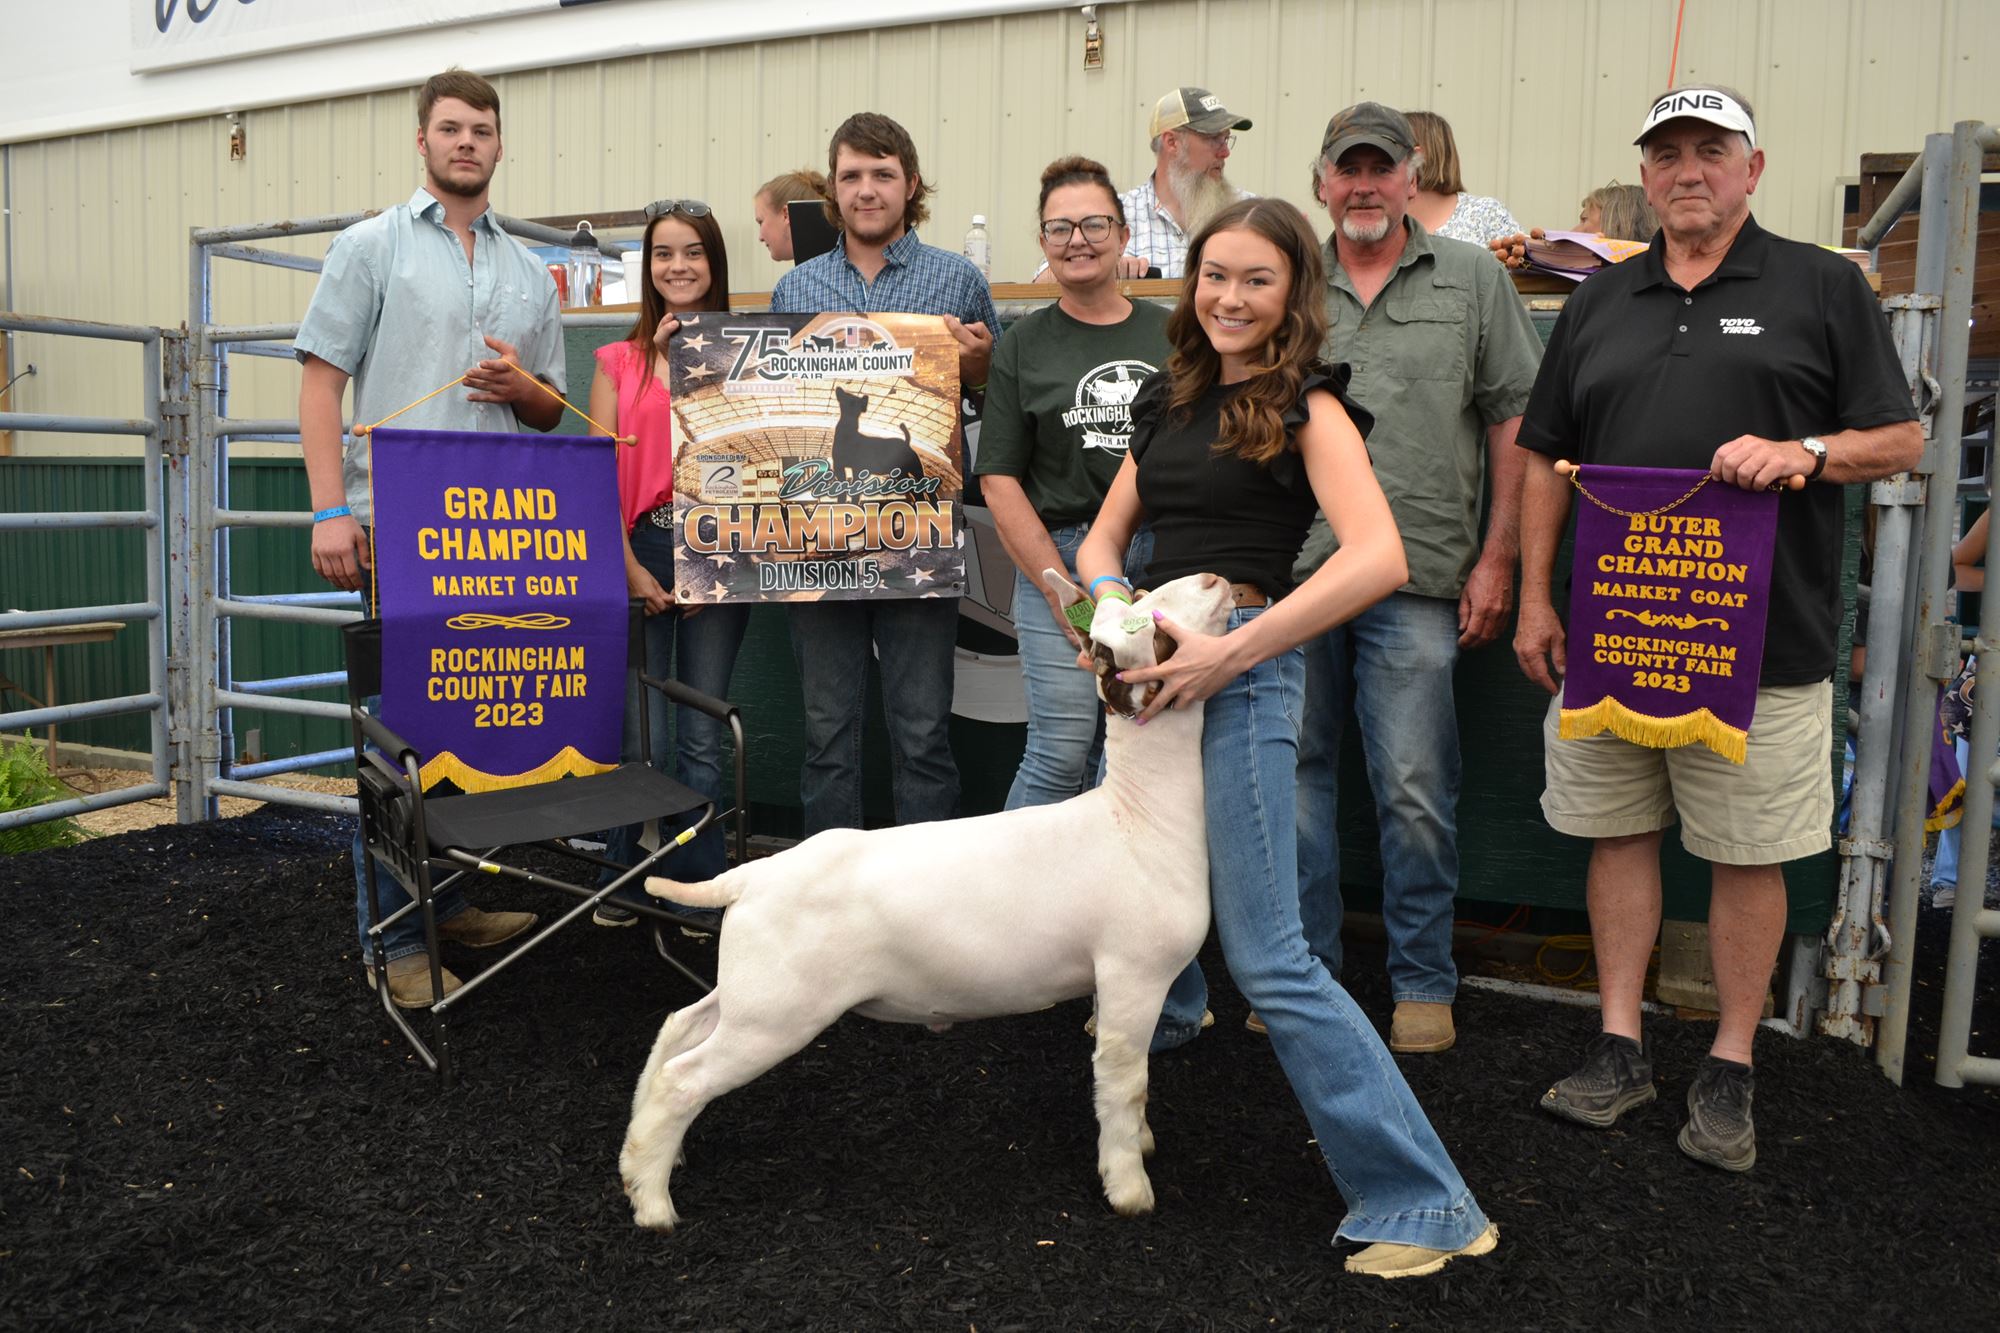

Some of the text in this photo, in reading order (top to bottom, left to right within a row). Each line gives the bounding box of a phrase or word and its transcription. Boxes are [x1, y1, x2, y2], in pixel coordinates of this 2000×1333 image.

[1653, 94, 1723, 121] PING
[1720, 318, 1755, 326] TOYO
[771, 354, 913, 372] ROCKINGHAM COUNTY
[1061, 405, 1132, 428] ROCKINGHA
[1111, 420, 1135, 434] Fa
[779, 458, 943, 499] Division
[444, 487, 557, 521] GRAND
[683, 501, 954, 553] CHAMPION
[1629, 514, 1722, 538] BUYER
[417, 528, 588, 561] CHAMPION
[1623, 535, 1724, 559] GRAND
[759, 559, 880, 591] DIVISION 5
[1597, 555, 1749, 583] CHAMPION
[432, 576, 579, 596] MARKET GOAT
[1592, 581, 1748, 608] MARKET GOAT
[431, 646, 585, 673] ROCKINGHAM
[1593, 633, 1737, 661] ROCKINGHAM
[1594, 649, 1733, 677] COUNTY FAIR
[427, 673, 588, 701] COUNTY FAIR
[1632, 671, 1691, 693] 2023
[474, 703, 544, 728] 2023
